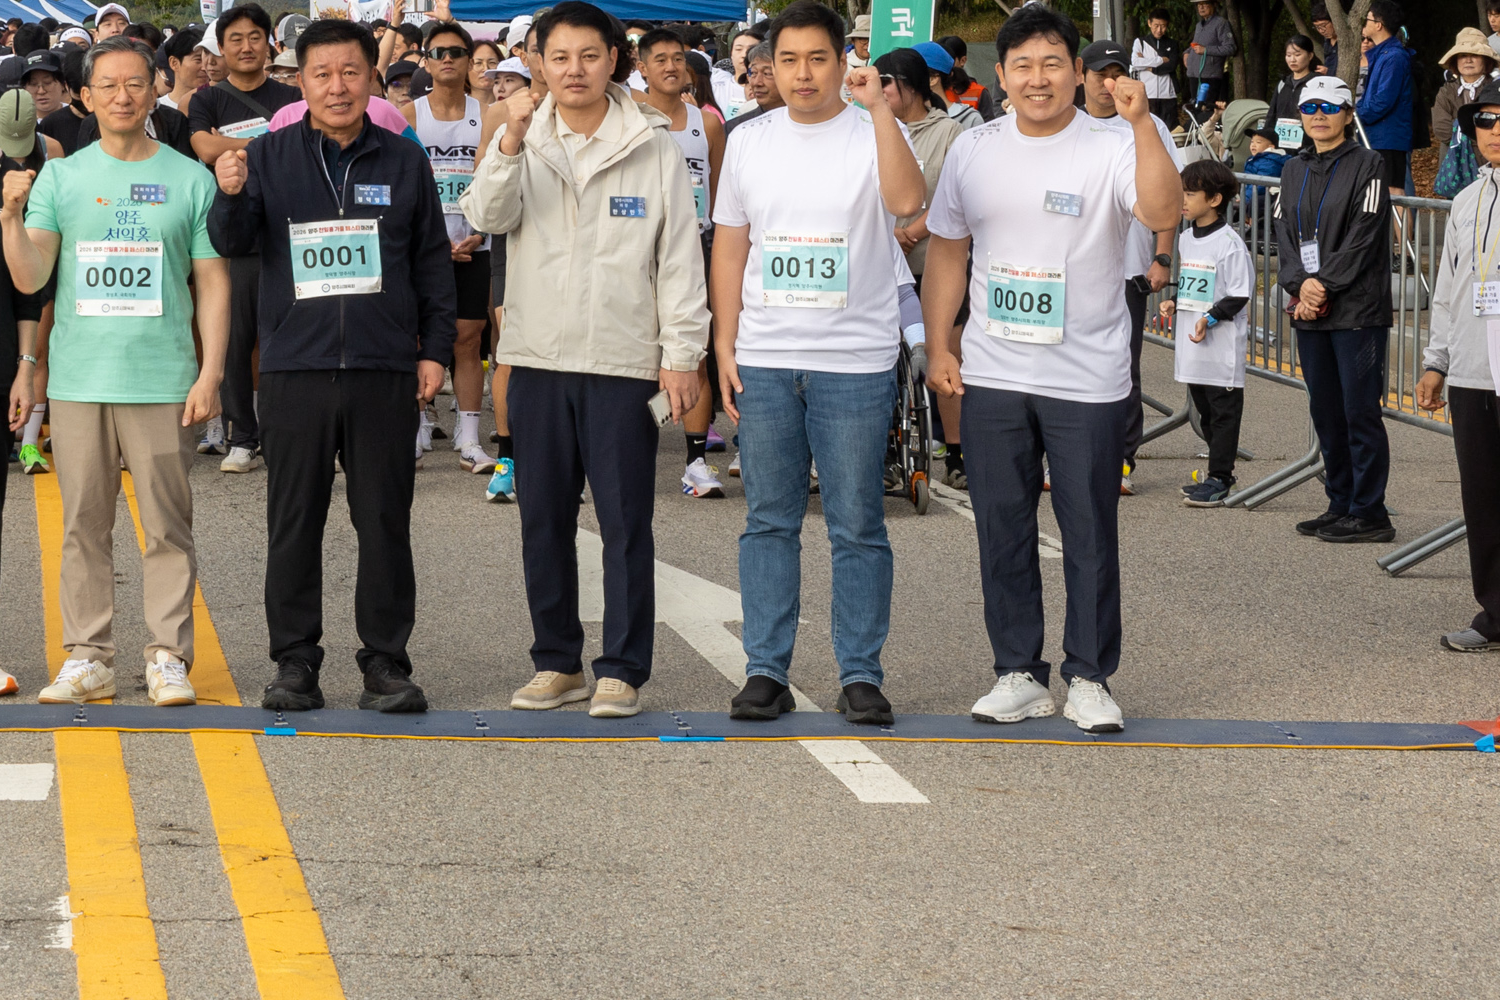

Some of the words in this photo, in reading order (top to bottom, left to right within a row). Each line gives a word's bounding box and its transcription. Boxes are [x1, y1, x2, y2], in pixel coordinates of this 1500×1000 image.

[436, 181, 471, 196] 518
[302, 245, 366, 269] 0001
[771, 256, 836, 279] 0013
[85, 267, 152, 288] 0002
[994, 287, 1052, 314] 0008
